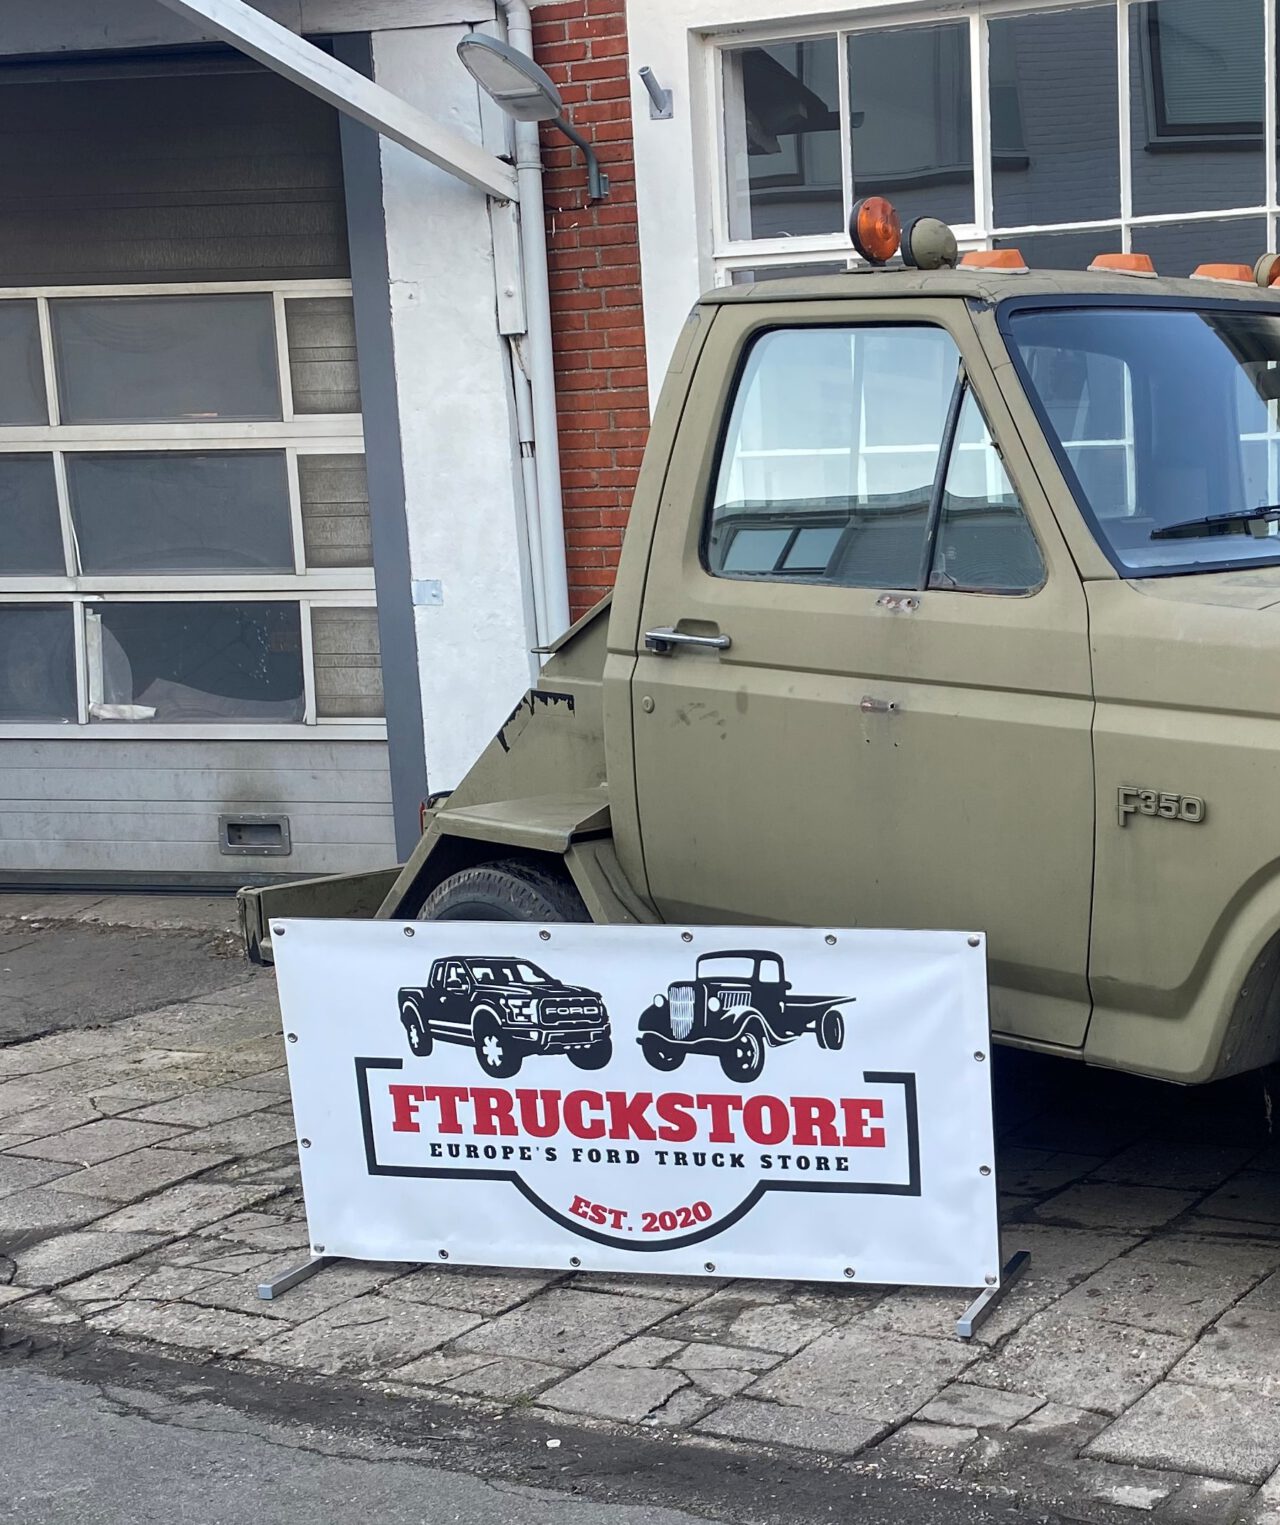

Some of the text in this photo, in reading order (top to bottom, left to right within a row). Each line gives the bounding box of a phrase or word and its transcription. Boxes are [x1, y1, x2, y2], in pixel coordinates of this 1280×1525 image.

[1117, 785, 1206, 827] F350
[545, 1006, 599, 1015] FORD
[388, 1084, 886, 1148] FTRUCKSTORE
[429, 1143, 849, 1171] EUROPE'S FORD TRUCK STORE
[568, 1195, 713, 1233] EST. 2020
